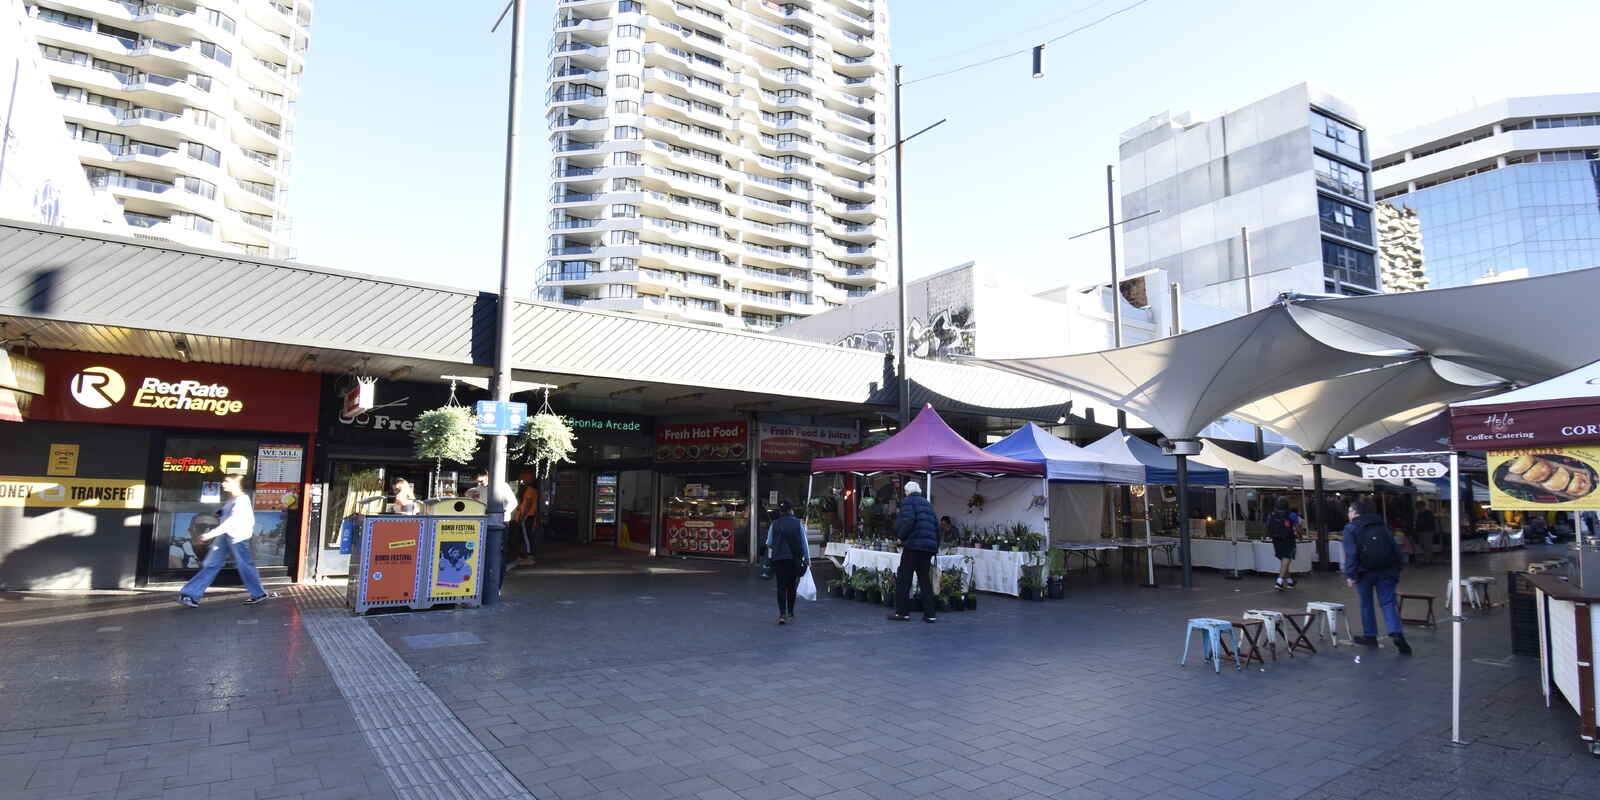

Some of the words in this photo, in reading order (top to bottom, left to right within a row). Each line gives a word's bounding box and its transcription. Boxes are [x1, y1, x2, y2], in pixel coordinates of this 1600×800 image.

[142, 377, 229, 398] RedRate
[133, 388, 243, 416] Exchange
[569, 417, 603, 429] Bronka
[606, 419, 641, 431] Arcade
[692, 427, 711, 439] Hot
[713, 425, 738, 437] Food
[1466, 433, 1494, 441] Coffee
[1495, 431, 1535, 440] Catering
[162, 461, 215, 473] Exchange
[1377, 465, 1437, 478] Coffee
[71, 486, 136, 500] TRANSFER
